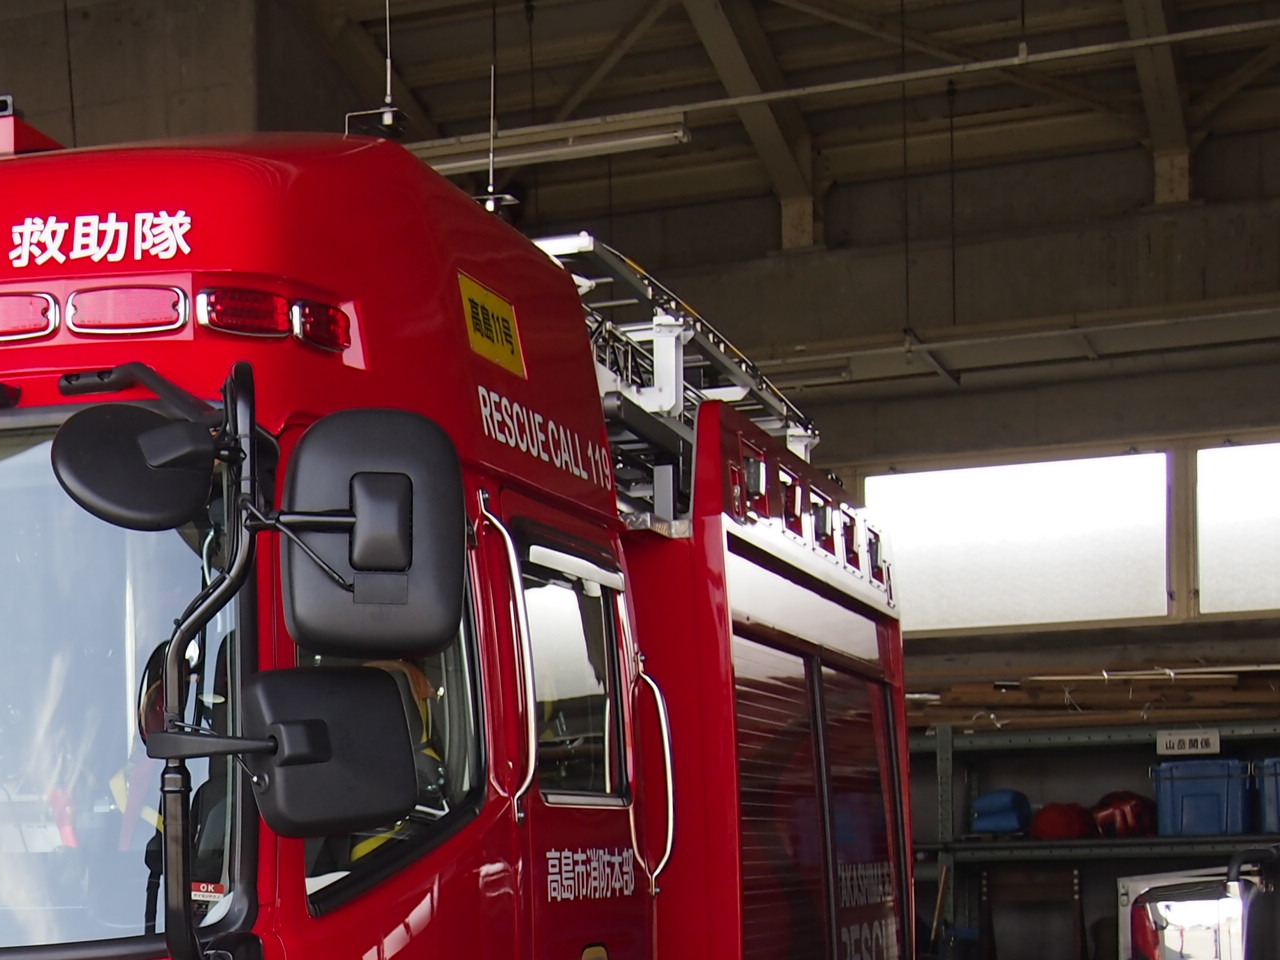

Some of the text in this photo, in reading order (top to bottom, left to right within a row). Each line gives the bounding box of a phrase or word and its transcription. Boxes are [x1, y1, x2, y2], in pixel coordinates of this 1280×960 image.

[9, 209, 192, 267] 救助隊
[478, 385, 612, 491] RESCUE CALL 119
[200, 883, 215, 892] OK
[546, 847, 635, 902] 高島市消防本部
